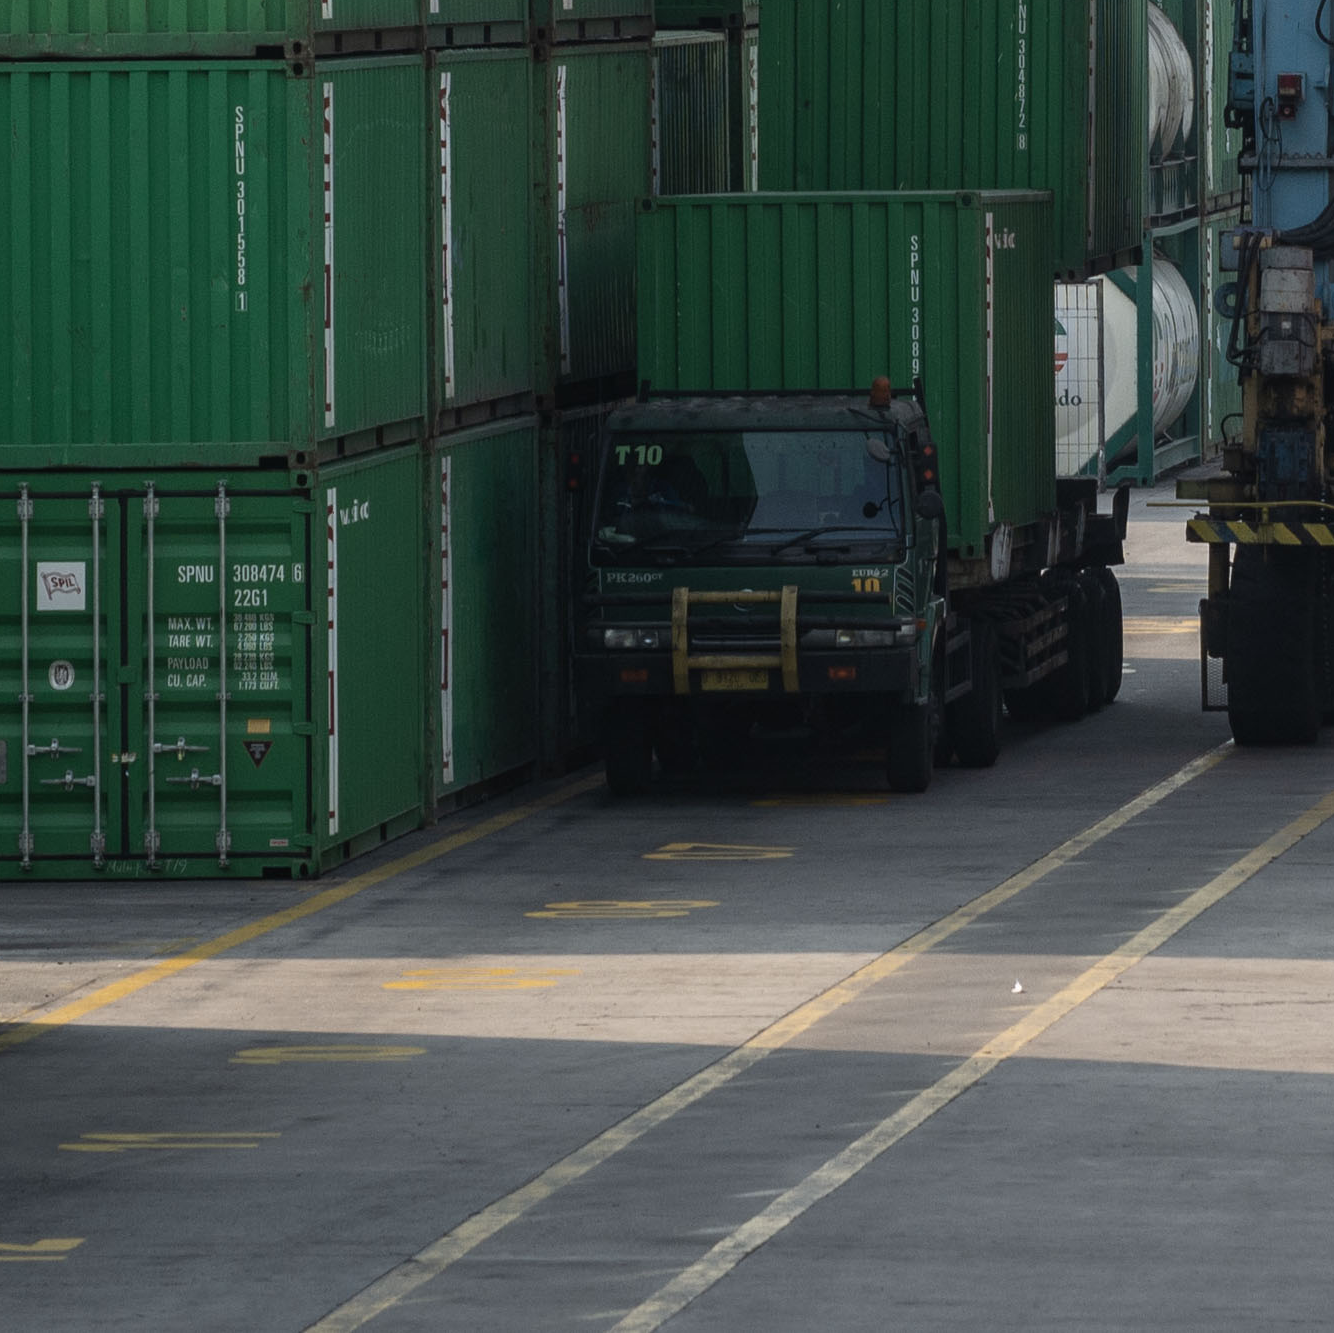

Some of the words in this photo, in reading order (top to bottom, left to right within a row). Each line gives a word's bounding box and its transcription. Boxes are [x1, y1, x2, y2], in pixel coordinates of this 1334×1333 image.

[1018, 39, 1026, 128] 304872
[235, 106, 244, 175] SPNU
[1017, 133, 1026, 150] 8
[236, 181, 245, 285] 301558
[910, 235, 919, 302] SPNU
[236, 292, 246, 311] 1
[1056, 389, 1082, 406] do
[615, 445, 630, 466] T
[634, 445, 662, 466] 10
[178, 565, 214, 583] SPNU
[233, 564, 284, 582] 308474
[293, 563, 303, 582] 6
[51, 577, 76, 589] SPIL
[852, 578, 880, 592] 10
[235, 589, 267, 607] 22G1
[168, 617, 194, 631] MAX.
[168, 634, 190, 648] TARE
[167, 657, 209, 669] PAYLOAD
[186, 674, 207, 687] CAP.
